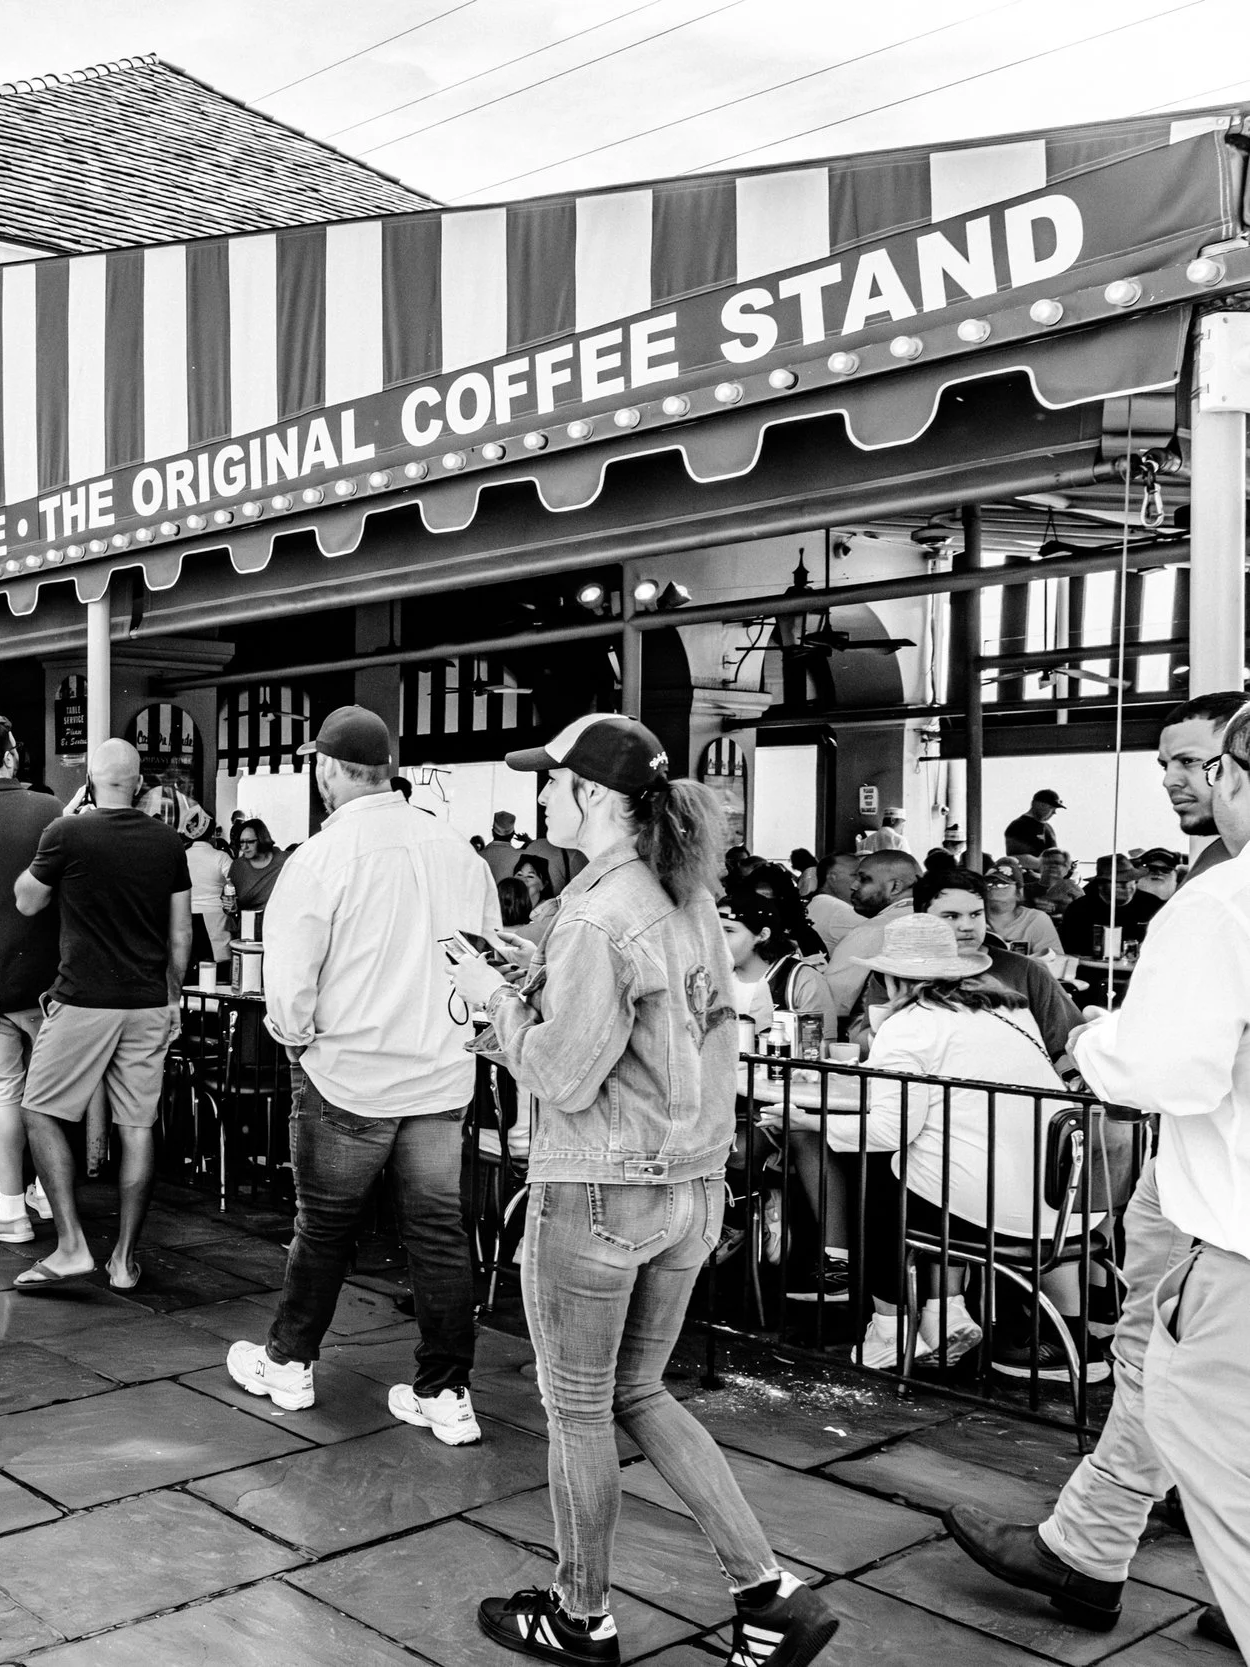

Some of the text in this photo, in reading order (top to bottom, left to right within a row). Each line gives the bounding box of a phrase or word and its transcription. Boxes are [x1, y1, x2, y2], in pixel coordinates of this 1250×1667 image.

[39, 479, 115, 542] THE
[132, 409, 375, 516] ORIGINAL
[401, 312, 679, 447] COFFEE
[721, 195, 1083, 363] STAND
[66, 705, 81, 714] TABLE
[63, 715, 84, 724] SERVICE
